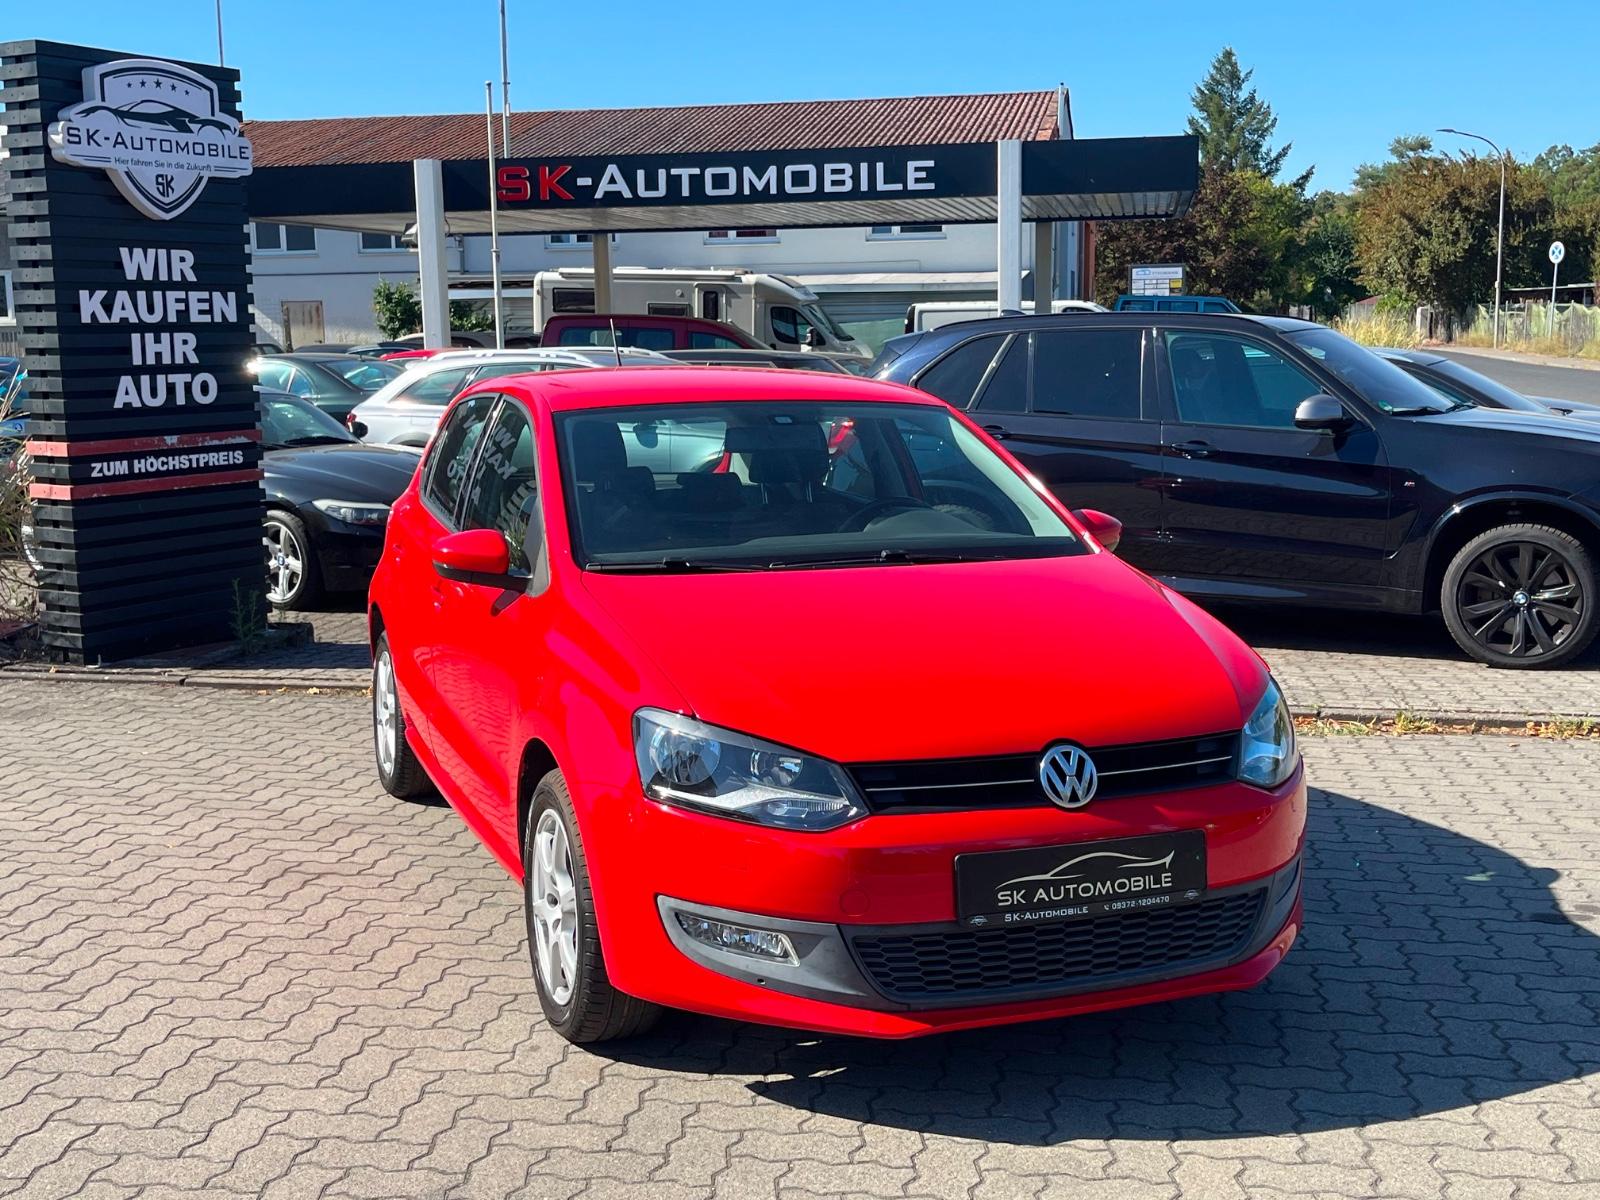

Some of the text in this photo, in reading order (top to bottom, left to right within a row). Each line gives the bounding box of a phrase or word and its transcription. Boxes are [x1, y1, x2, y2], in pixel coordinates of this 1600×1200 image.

[66, 126, 250, 160] SK-AUTOMOBILE
[114, 156, 212, 172] Hier fahren Sie in die Zukunft
[496, 159, 936, 201] SK-AUTOMOBILE
[155, 173, 175, 198] SK
[119, 246, 198, 282] WIR
[78, 289, 238, 324] KAUFEN
[130, 332, 199, 366] IHR
[113, 372, 218, 409] AUTO
[91, 450, 244, 478] ZUM HÖCHSTPREIS
[997, 872, 1173, 907] SK AUTOMOBILE
[1004, 906, 1089, 922] SK-AUTOMOBILE
